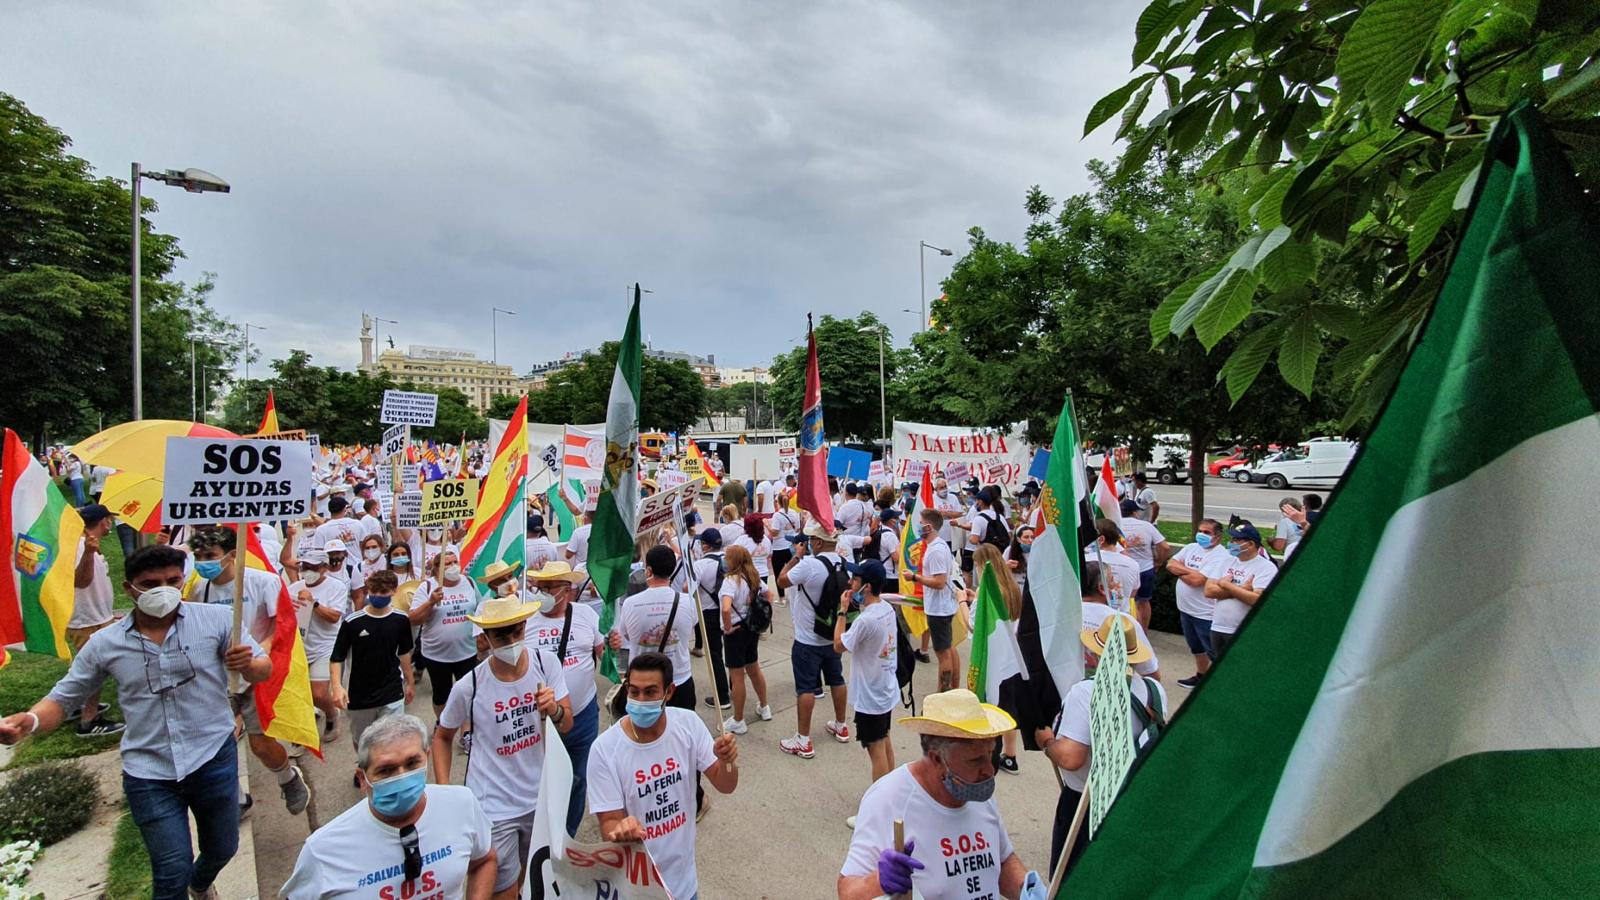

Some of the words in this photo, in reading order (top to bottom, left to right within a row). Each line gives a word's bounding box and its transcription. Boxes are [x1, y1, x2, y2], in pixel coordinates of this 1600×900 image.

[384, 410, 434, 418] QUEREMOS
[386, 436, 405, 456] SOS
[908, 433, 918, 450] Y
[922, 434, 944, 452] LA
[948, 435, 1008, 454] FERIA
[203, 444, 282, 475] SOS
[190, 480, 292, 497] AYUDAS
[433, 482, 464, 498] SOS
[169, 500, 304, 520] URGENTES
[422, 508, 474, 522] URGENTES
[428, 500, 468, 511] AYUDAS
[496, 713, 509, 724] LA
[511, 703, 538, 720] FERIA
[512, 718, 524, 729] SE
[502, 725, 535, 744] MUERE
[496, 734, 541, 756] GRANADA
[635, 758, 680, 784] S.O.S.
[638, 784, 652, 798] LA
[654, 770, 682, 792] FERIA
[656, 791, 668, 806] SE
[645, 800, 680, 824] MUERE
[940, 832, 990, 857] S.O.S.
[945, 859, 961, 877] LA
[963, 852, 995, 873] FERIA
[379, 870, 442, 900] S.O.S.
[966, 876, 981, 894] SE
